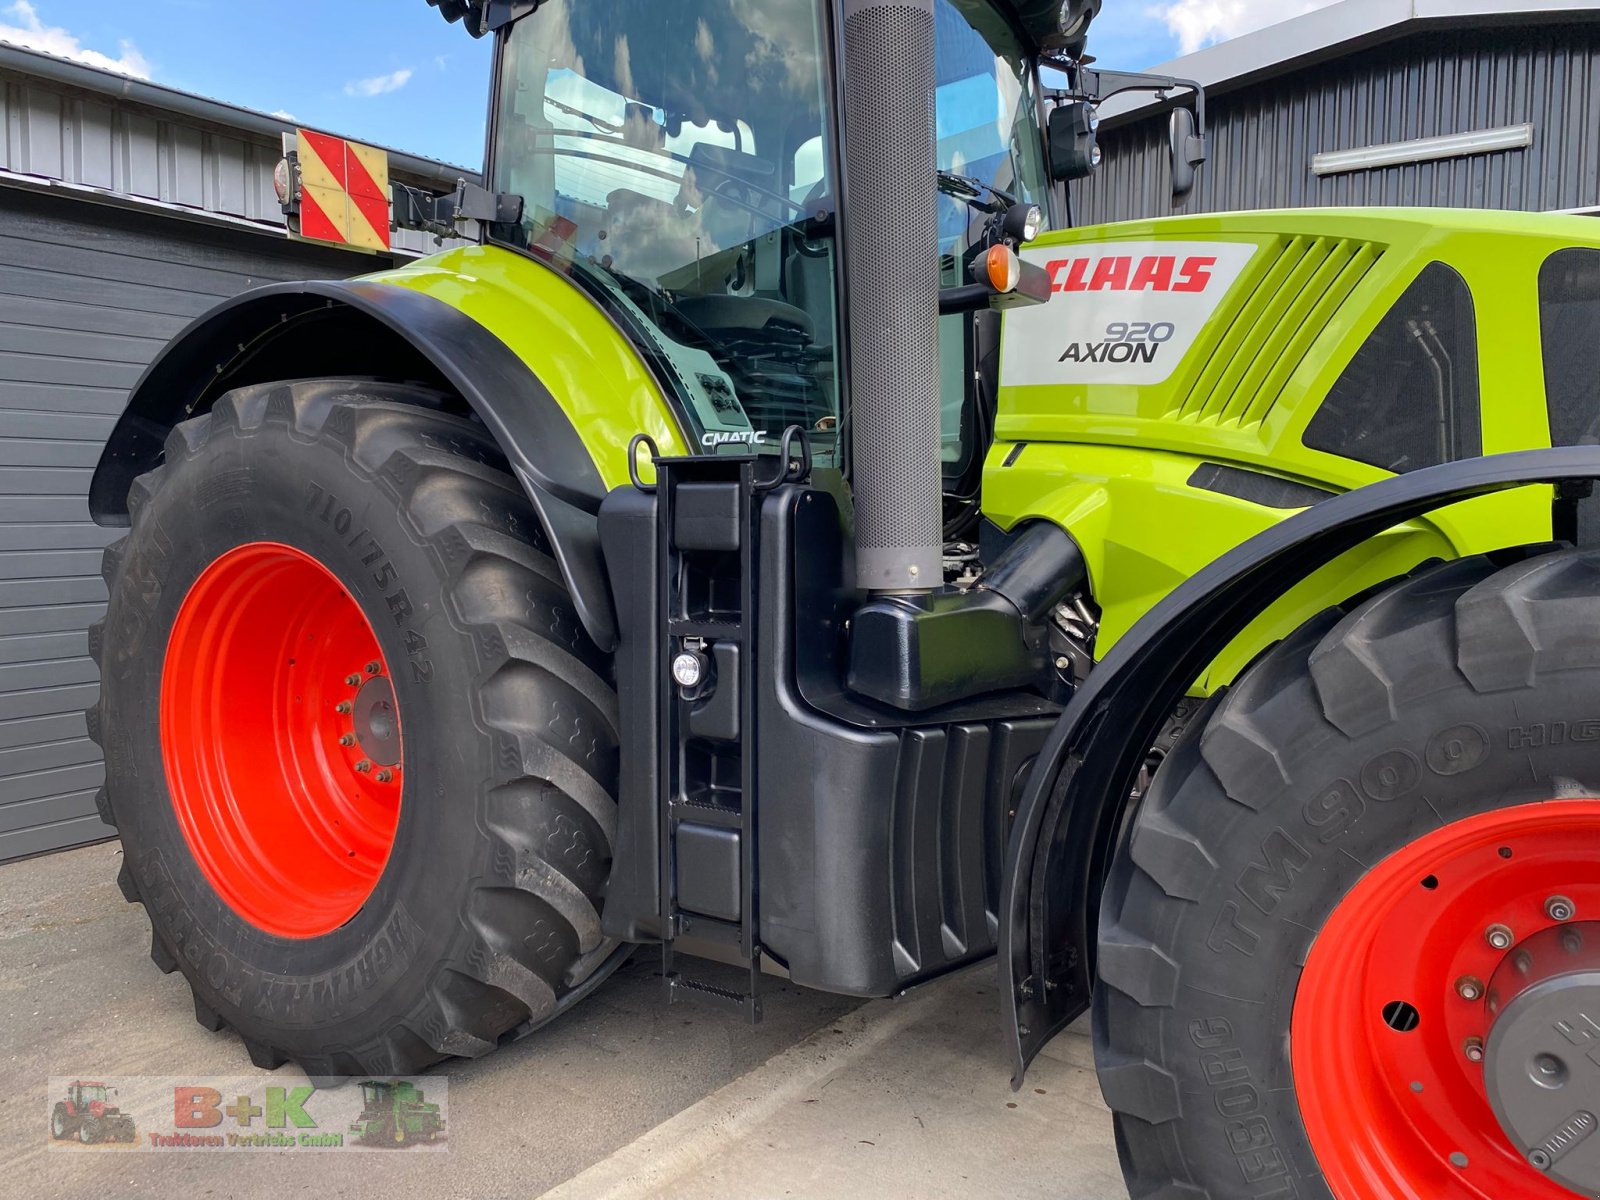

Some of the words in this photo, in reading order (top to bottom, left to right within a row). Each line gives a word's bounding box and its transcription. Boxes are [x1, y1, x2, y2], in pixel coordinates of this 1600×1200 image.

[1045, 256, 1217, 292] CLAAS
[1104, 322, 1175, 342] 920
[1058, 342, 1159, 363] AXION
[701, 430, 767, 446] CMATIC
